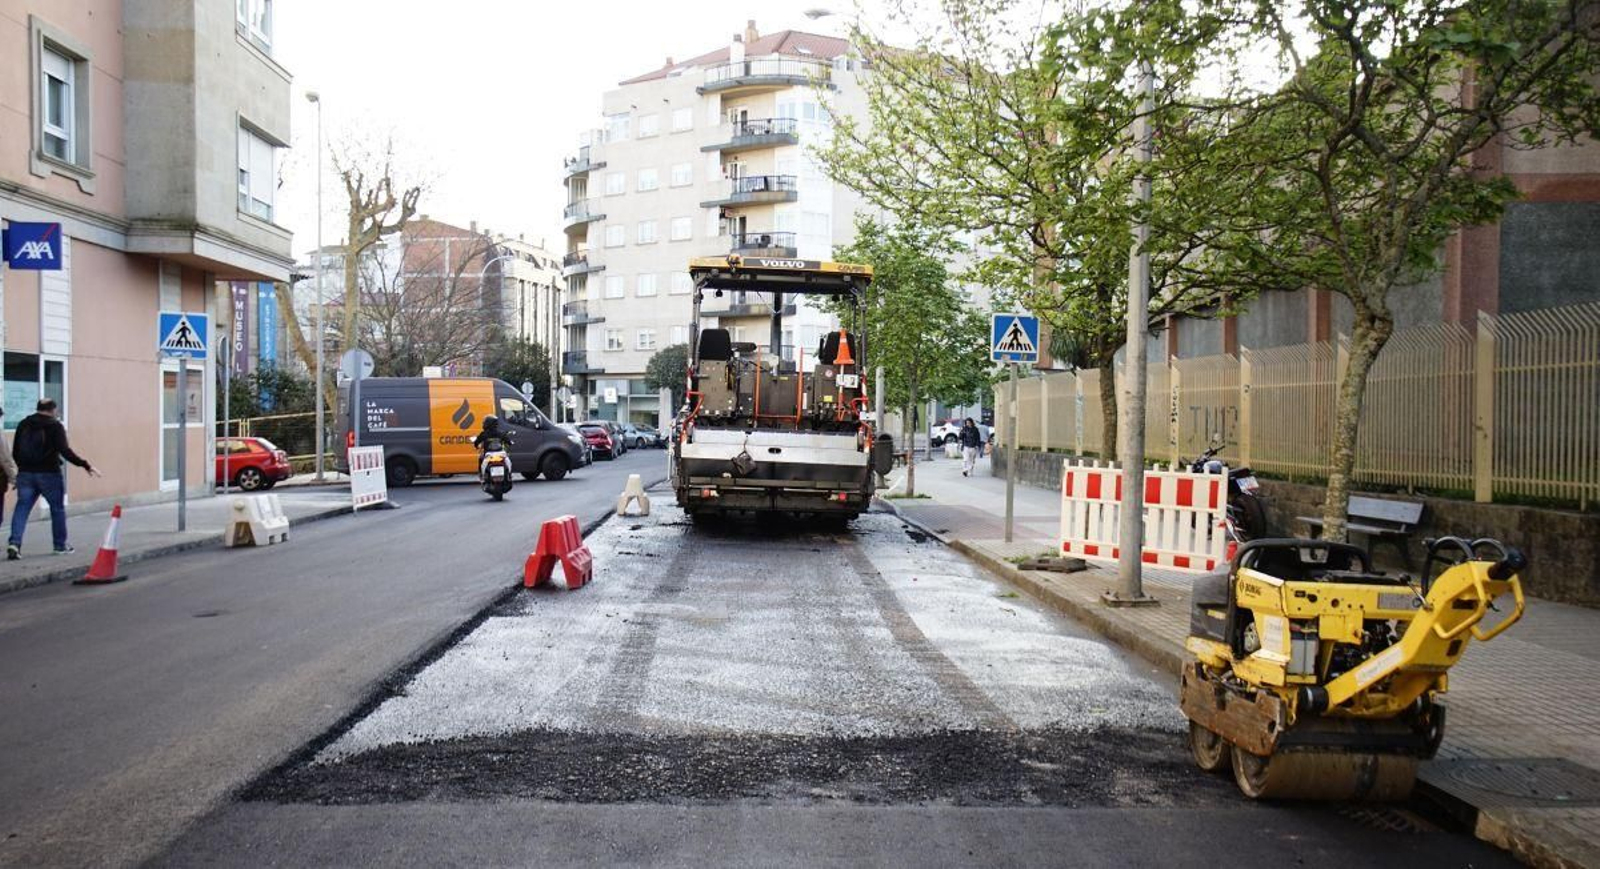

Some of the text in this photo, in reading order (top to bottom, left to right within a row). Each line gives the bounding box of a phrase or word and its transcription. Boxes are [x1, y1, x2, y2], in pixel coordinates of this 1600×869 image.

[14, 241, 54, 259] AXA
[760, 259, 805, 269] VOLVO
[235, 300, 244, 352] MUSEO
[367, 421, 388, 429] CAFÉ
[439, 435, 474, 445] CANDE
